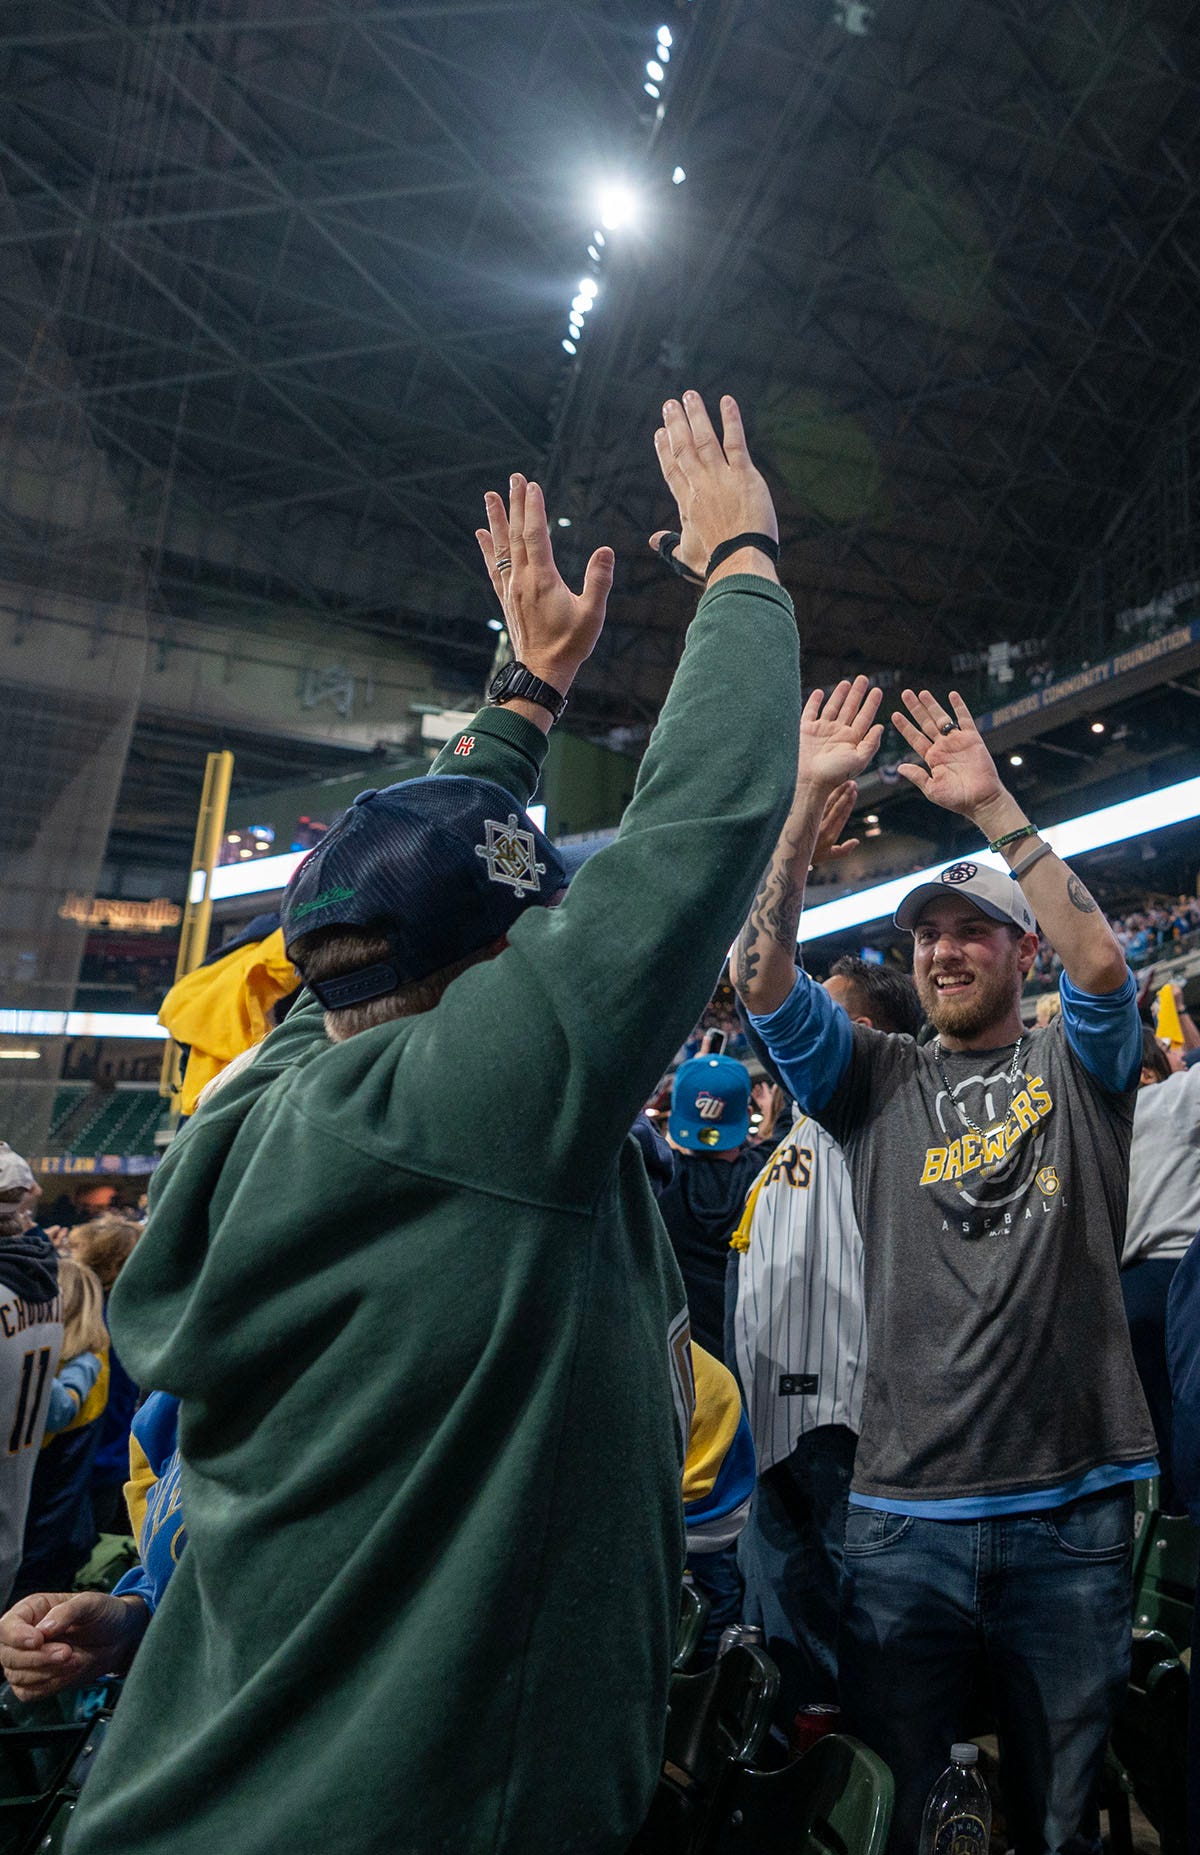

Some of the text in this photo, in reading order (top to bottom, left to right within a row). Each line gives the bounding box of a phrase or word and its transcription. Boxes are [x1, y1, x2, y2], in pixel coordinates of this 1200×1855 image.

[1113, 625, 1192, 675] FOUNDATION
[454, 735, 476, 757] H
[919, 1076, 1053, 1186] BREWERS
[941, 1196, 1068, 1232] ASEBALL
[8, 1345, 52, 1455] 11
